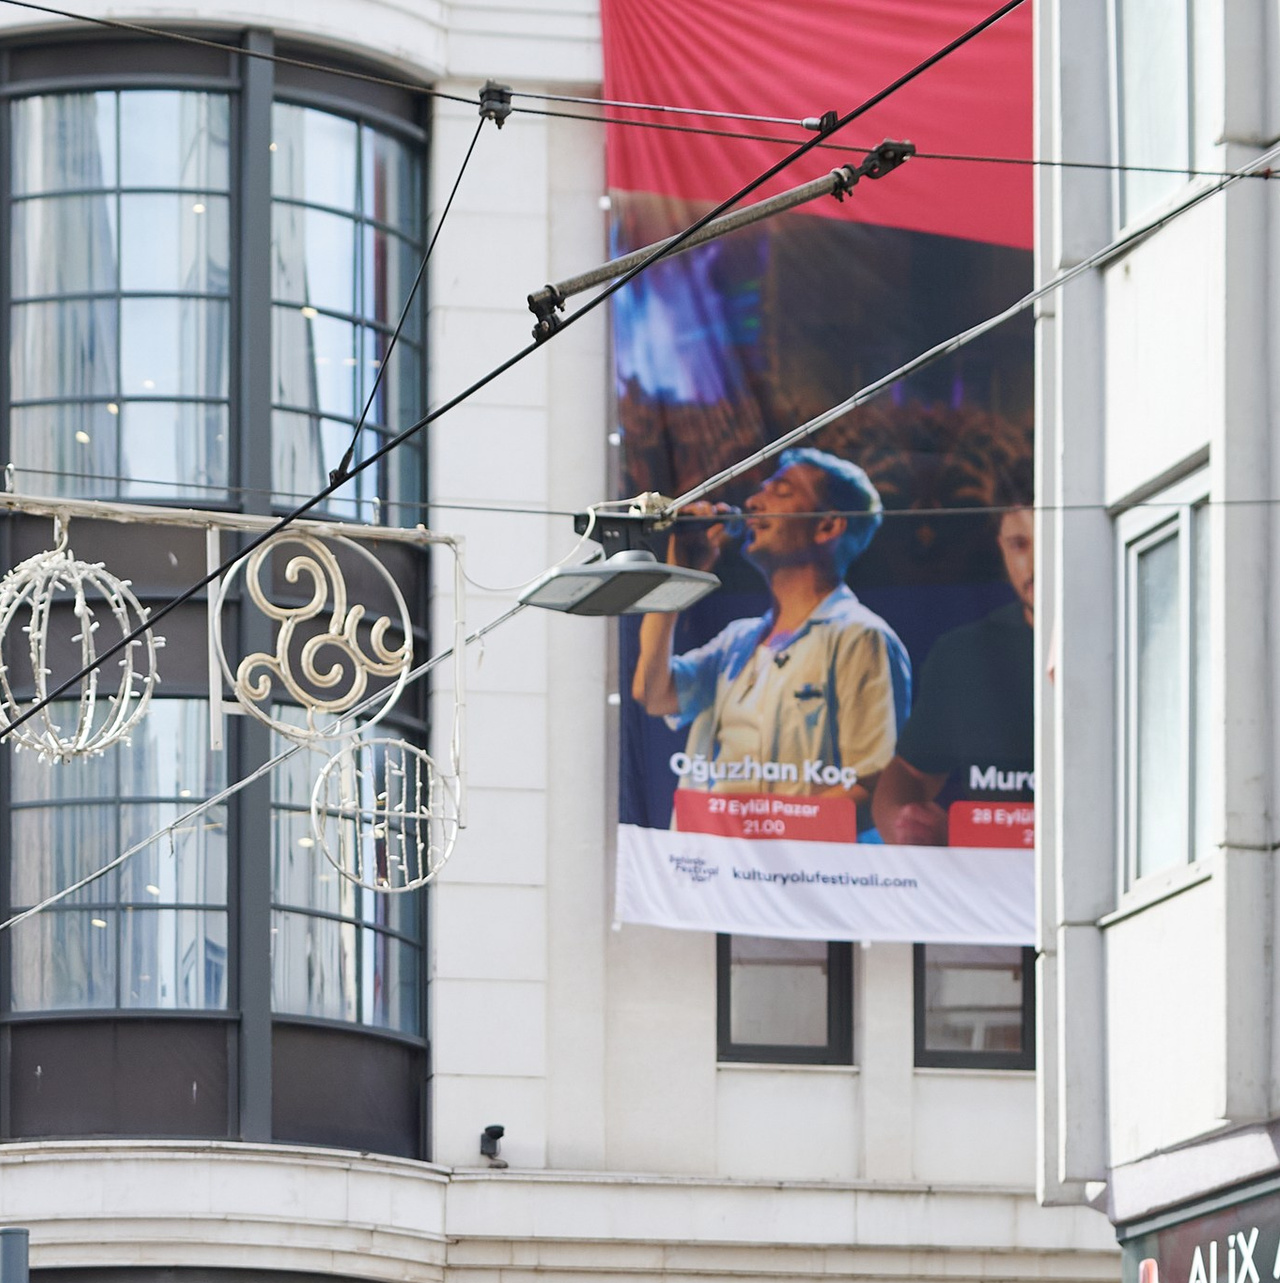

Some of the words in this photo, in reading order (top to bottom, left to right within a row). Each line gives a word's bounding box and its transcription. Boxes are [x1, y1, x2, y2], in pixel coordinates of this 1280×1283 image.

[670, 752, 799, 783] Oğuzhan
[803, 758, 858, 790] Koç
[772, 801, 819, 816] Pazar
[743, 819, 785, 835] 21.00
